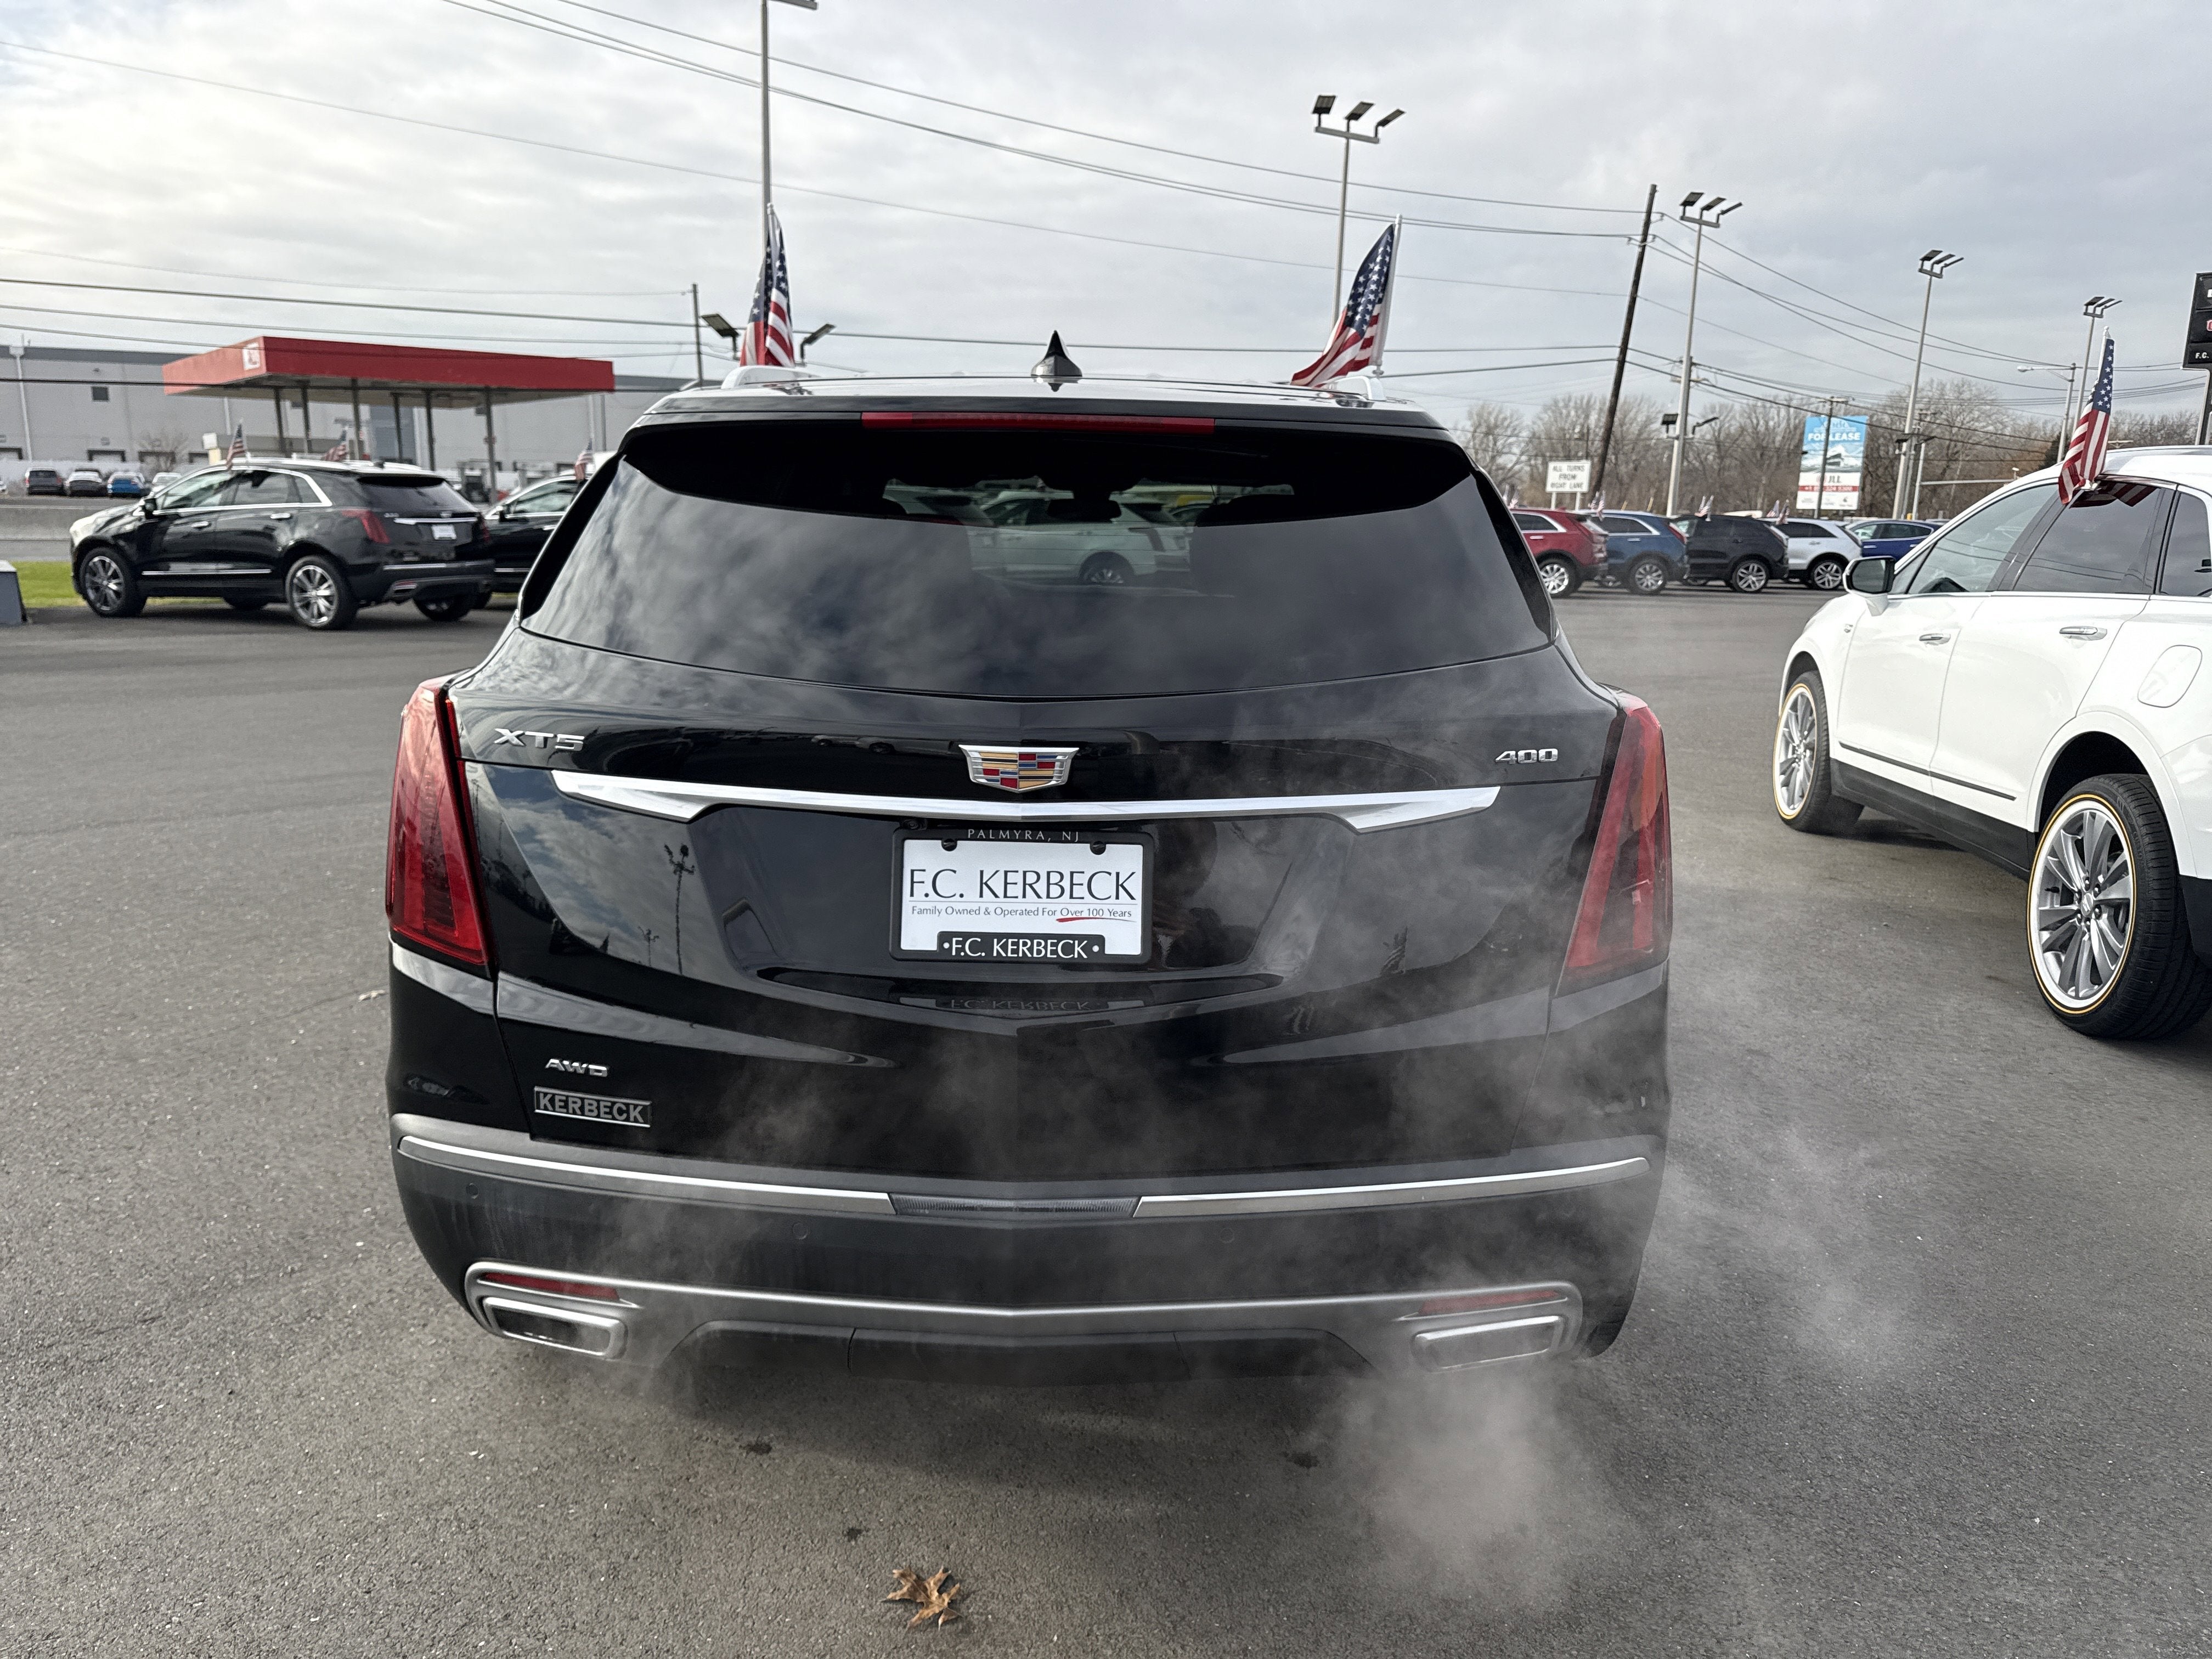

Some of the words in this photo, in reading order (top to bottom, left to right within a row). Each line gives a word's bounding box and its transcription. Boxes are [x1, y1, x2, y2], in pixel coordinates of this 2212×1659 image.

[1830, 432, 1861, 441] LEASE
[1494, 748, 1558, 764] 400
[967, 829, 1051, 842] PALMYRA,
[1062, 831, 1080, 843] NJ
[909, 868, 964, 899] F.C.
[979, 869, 1136, 901] KERBECK
[912, 905, 943, 917] Family
[945, 906, 980, 916] Owned
[984, 907, 991, 916] &
[994, 906, 1039, 918] Operated
[1042, 907, 1058, 917] For
[1060, 907, 1084, 917] Over
[1087, 908, 1104, 917] 100
[1107, 908, 1132, 918] Years
[951, 938, 985, 957] F.C.
[992, 938, 1088, 959] KERBECK
[545, 1058, 608, 1077] AWD
[540, 1092, 645, 1123] KERBECK
